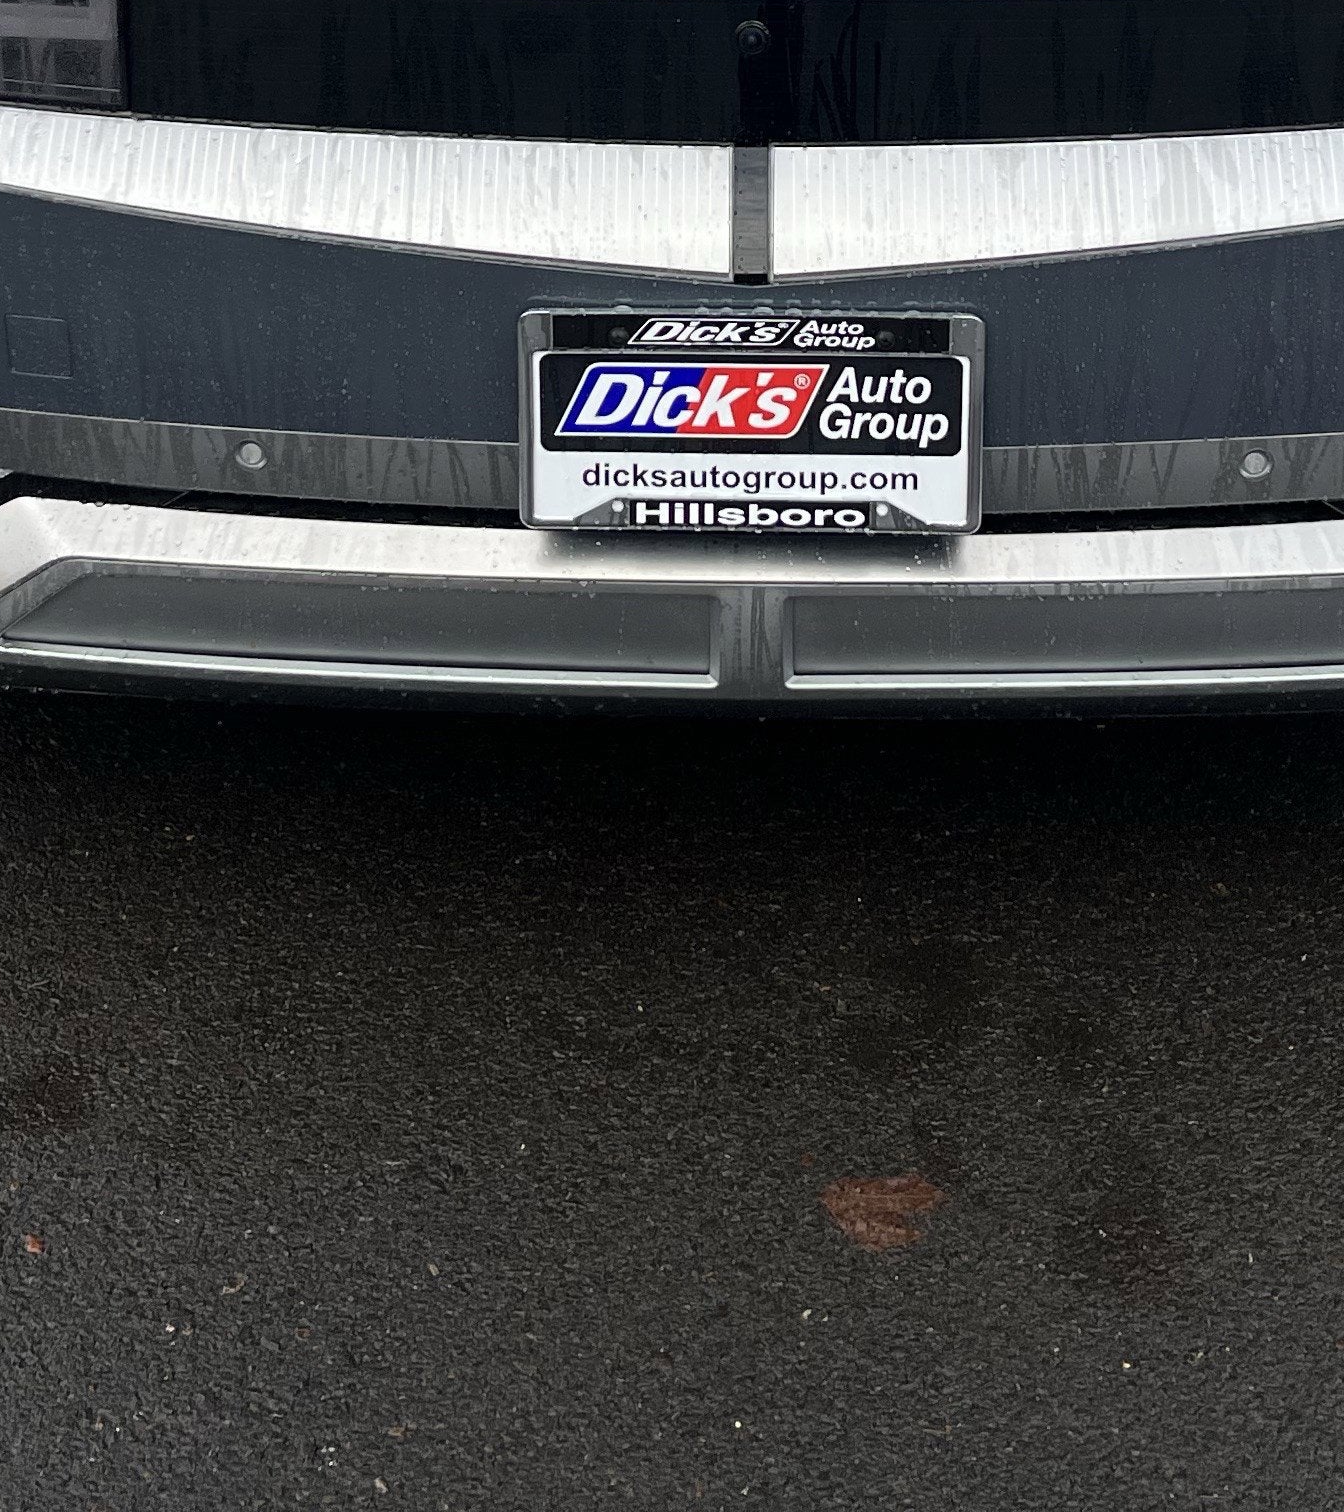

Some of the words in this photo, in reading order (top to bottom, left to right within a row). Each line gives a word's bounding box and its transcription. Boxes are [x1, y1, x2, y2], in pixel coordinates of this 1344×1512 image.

[793, 332, 877, 351] Group
[799, 320, 865, 335] Auto
[574, 371, 799, 429] Dick's
[825, 366, 932, 404] Auto
[818, 402, 950, 449] Group
[581, 462, 919, 495] dicksautogroup.com
[634, 501, 867, 527] Hillsboro
